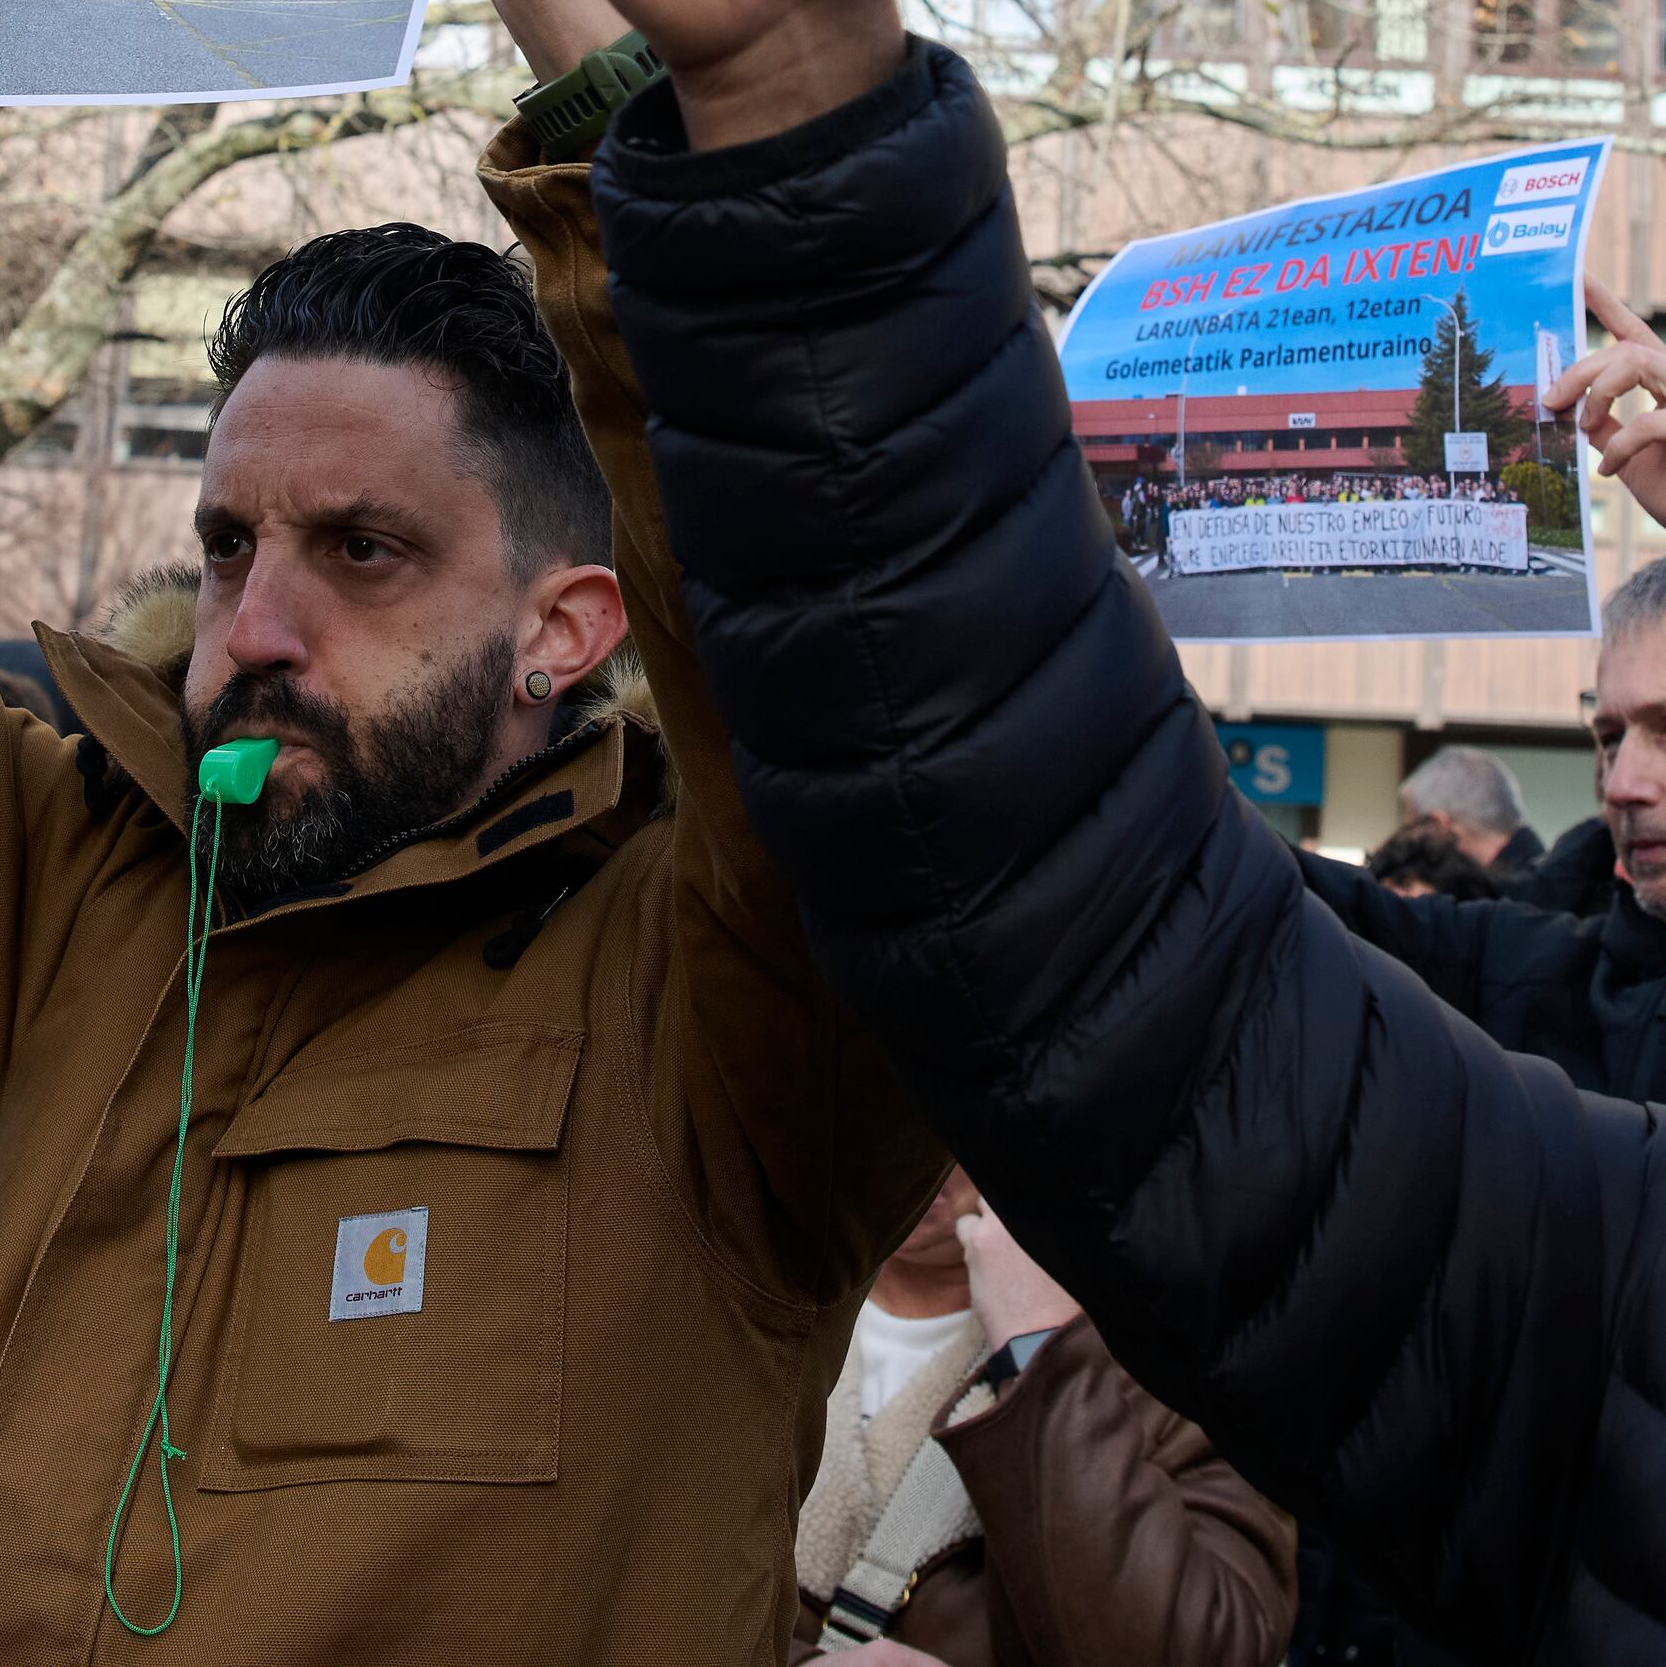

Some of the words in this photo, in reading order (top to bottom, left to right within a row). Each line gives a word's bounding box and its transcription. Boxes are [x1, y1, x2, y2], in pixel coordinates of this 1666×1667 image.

[1524, 172, 1581, 192] BOSCH
[1164, 187, 1473, 270] MANIFESTAZIOA
[1512, 222, 1568, 238] Balay
[1139, 270, 1218, 312] BSH
[1221, 262, 1272, 300] EZ
[1275, 253, 1330, 294] DA
[1342, 233, 1480, 286] IXTEN!
[1135, 310, 1261, 342] LARUNBATA
[1266, 306, 1336, 330] 21ean,
[1346, 297, 1422, 322] 12etan
[1104, 353, 1234, 381] Golemetatik
[1239, 333, 1433, 370] Parlamenturaino
[1172, 517, 1192, 540] EN
[1254, 512, 1273, 534] DE
[1278, 511, 1346, 534] NUESTRO
[1353, 509, 1409, 533] EMPLEO
[1428, 504, 1483, 526] FUTURO
[1471, 538, 1509, 564] ALDE
[345, 1286, 403, 1302] carhartt
